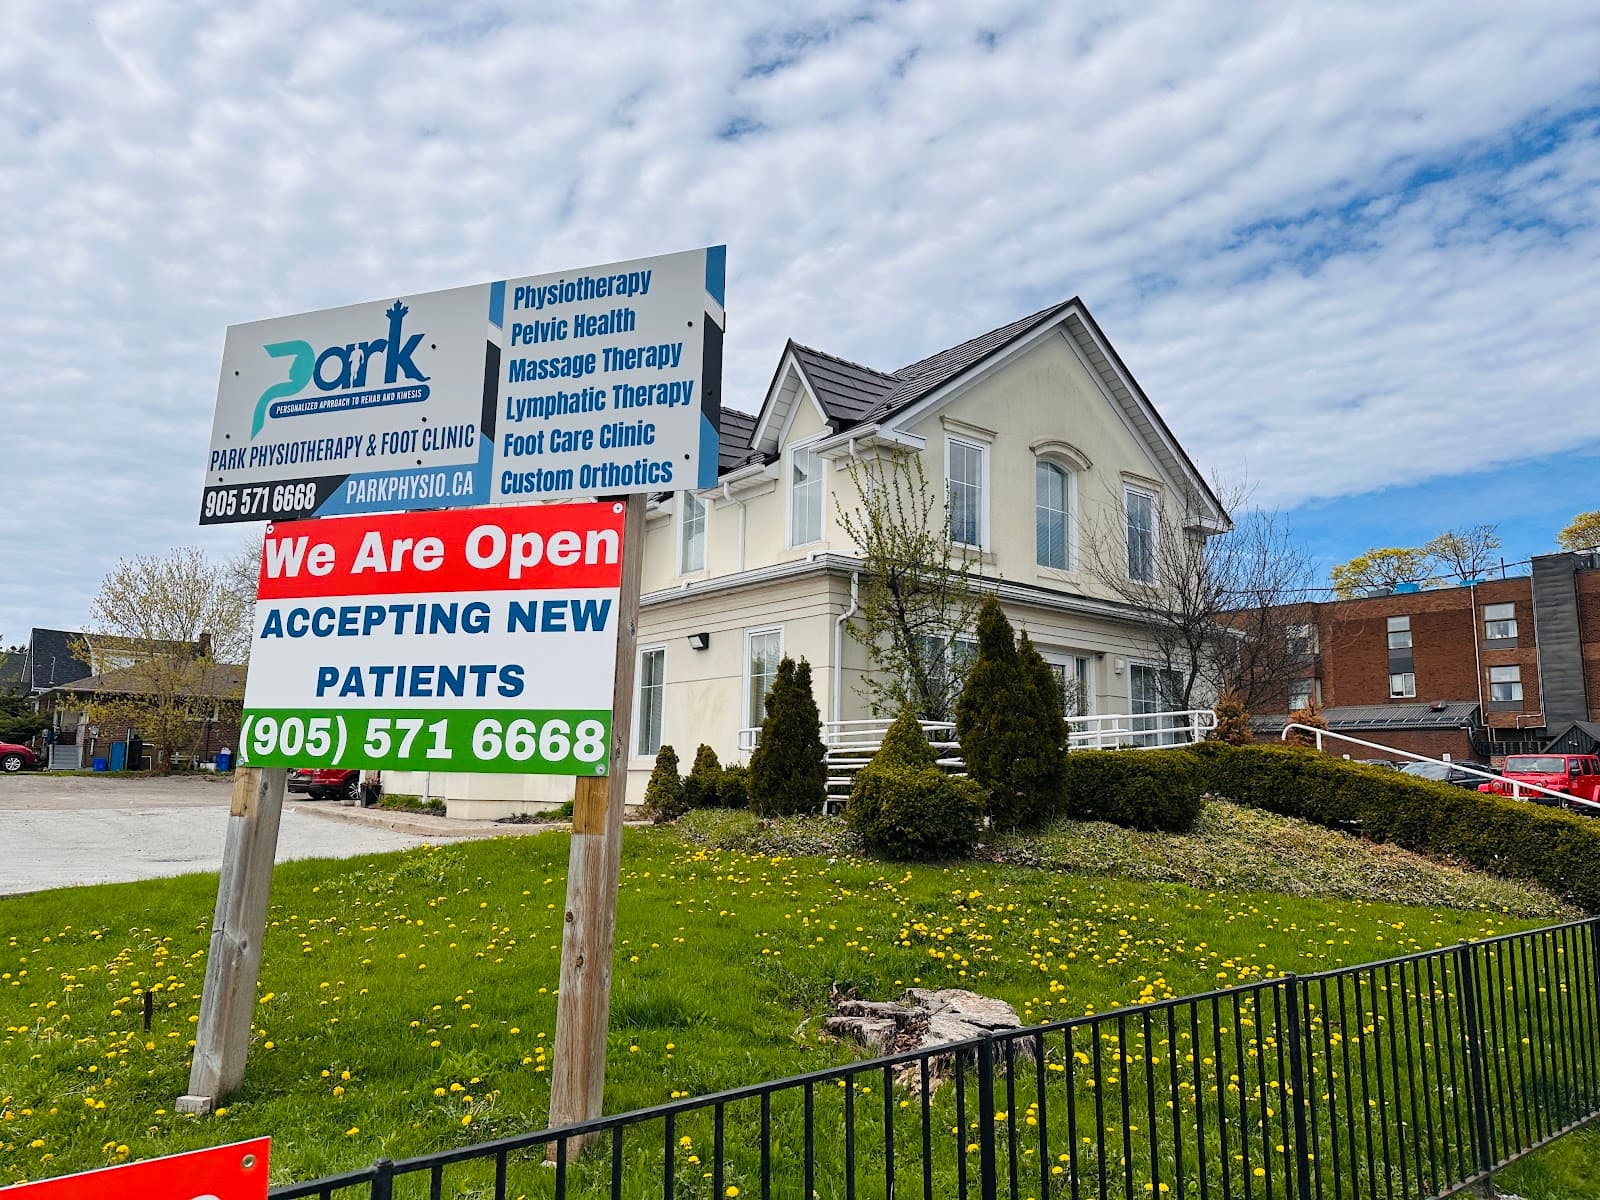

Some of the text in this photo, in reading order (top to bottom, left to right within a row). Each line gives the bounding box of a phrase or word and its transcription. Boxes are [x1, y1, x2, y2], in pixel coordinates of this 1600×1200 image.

[513, 270, 652, 310] Physiotherapy
[511, 308, 636, 346] Pelvic Health
[508, 342, 683, 383] Massage Therapy
[276, 402, 318, 414] PERSONALIZED
[351, 397, 360, 405] TO
[360, 395, 381, 404] REHAB
[382, 393, 395, 401] AND
[396, 388, 422, 400] KINESIS
[506, 380, 694, 422] Lymphatic Therapy
[210, 424, 475, 471] PARK PHYSIOTHERAPY & FOOT CLINIC
[503, 420, 656, 457] Foot Care Clinic
[346, 470, 474, 504] PARKPHYSIO.CA
[501, 459, 673, 495] Custom Orthotics
[205, 482, 317, 517] 905 571 6668
[265, 525, 619, 580] We Are Open
[260, 599, 613, 639] ACCEPTING NEW
[316, 664, 526, 698] PATIENTS
[238, 714, 606, 766] (905) 571 6668
